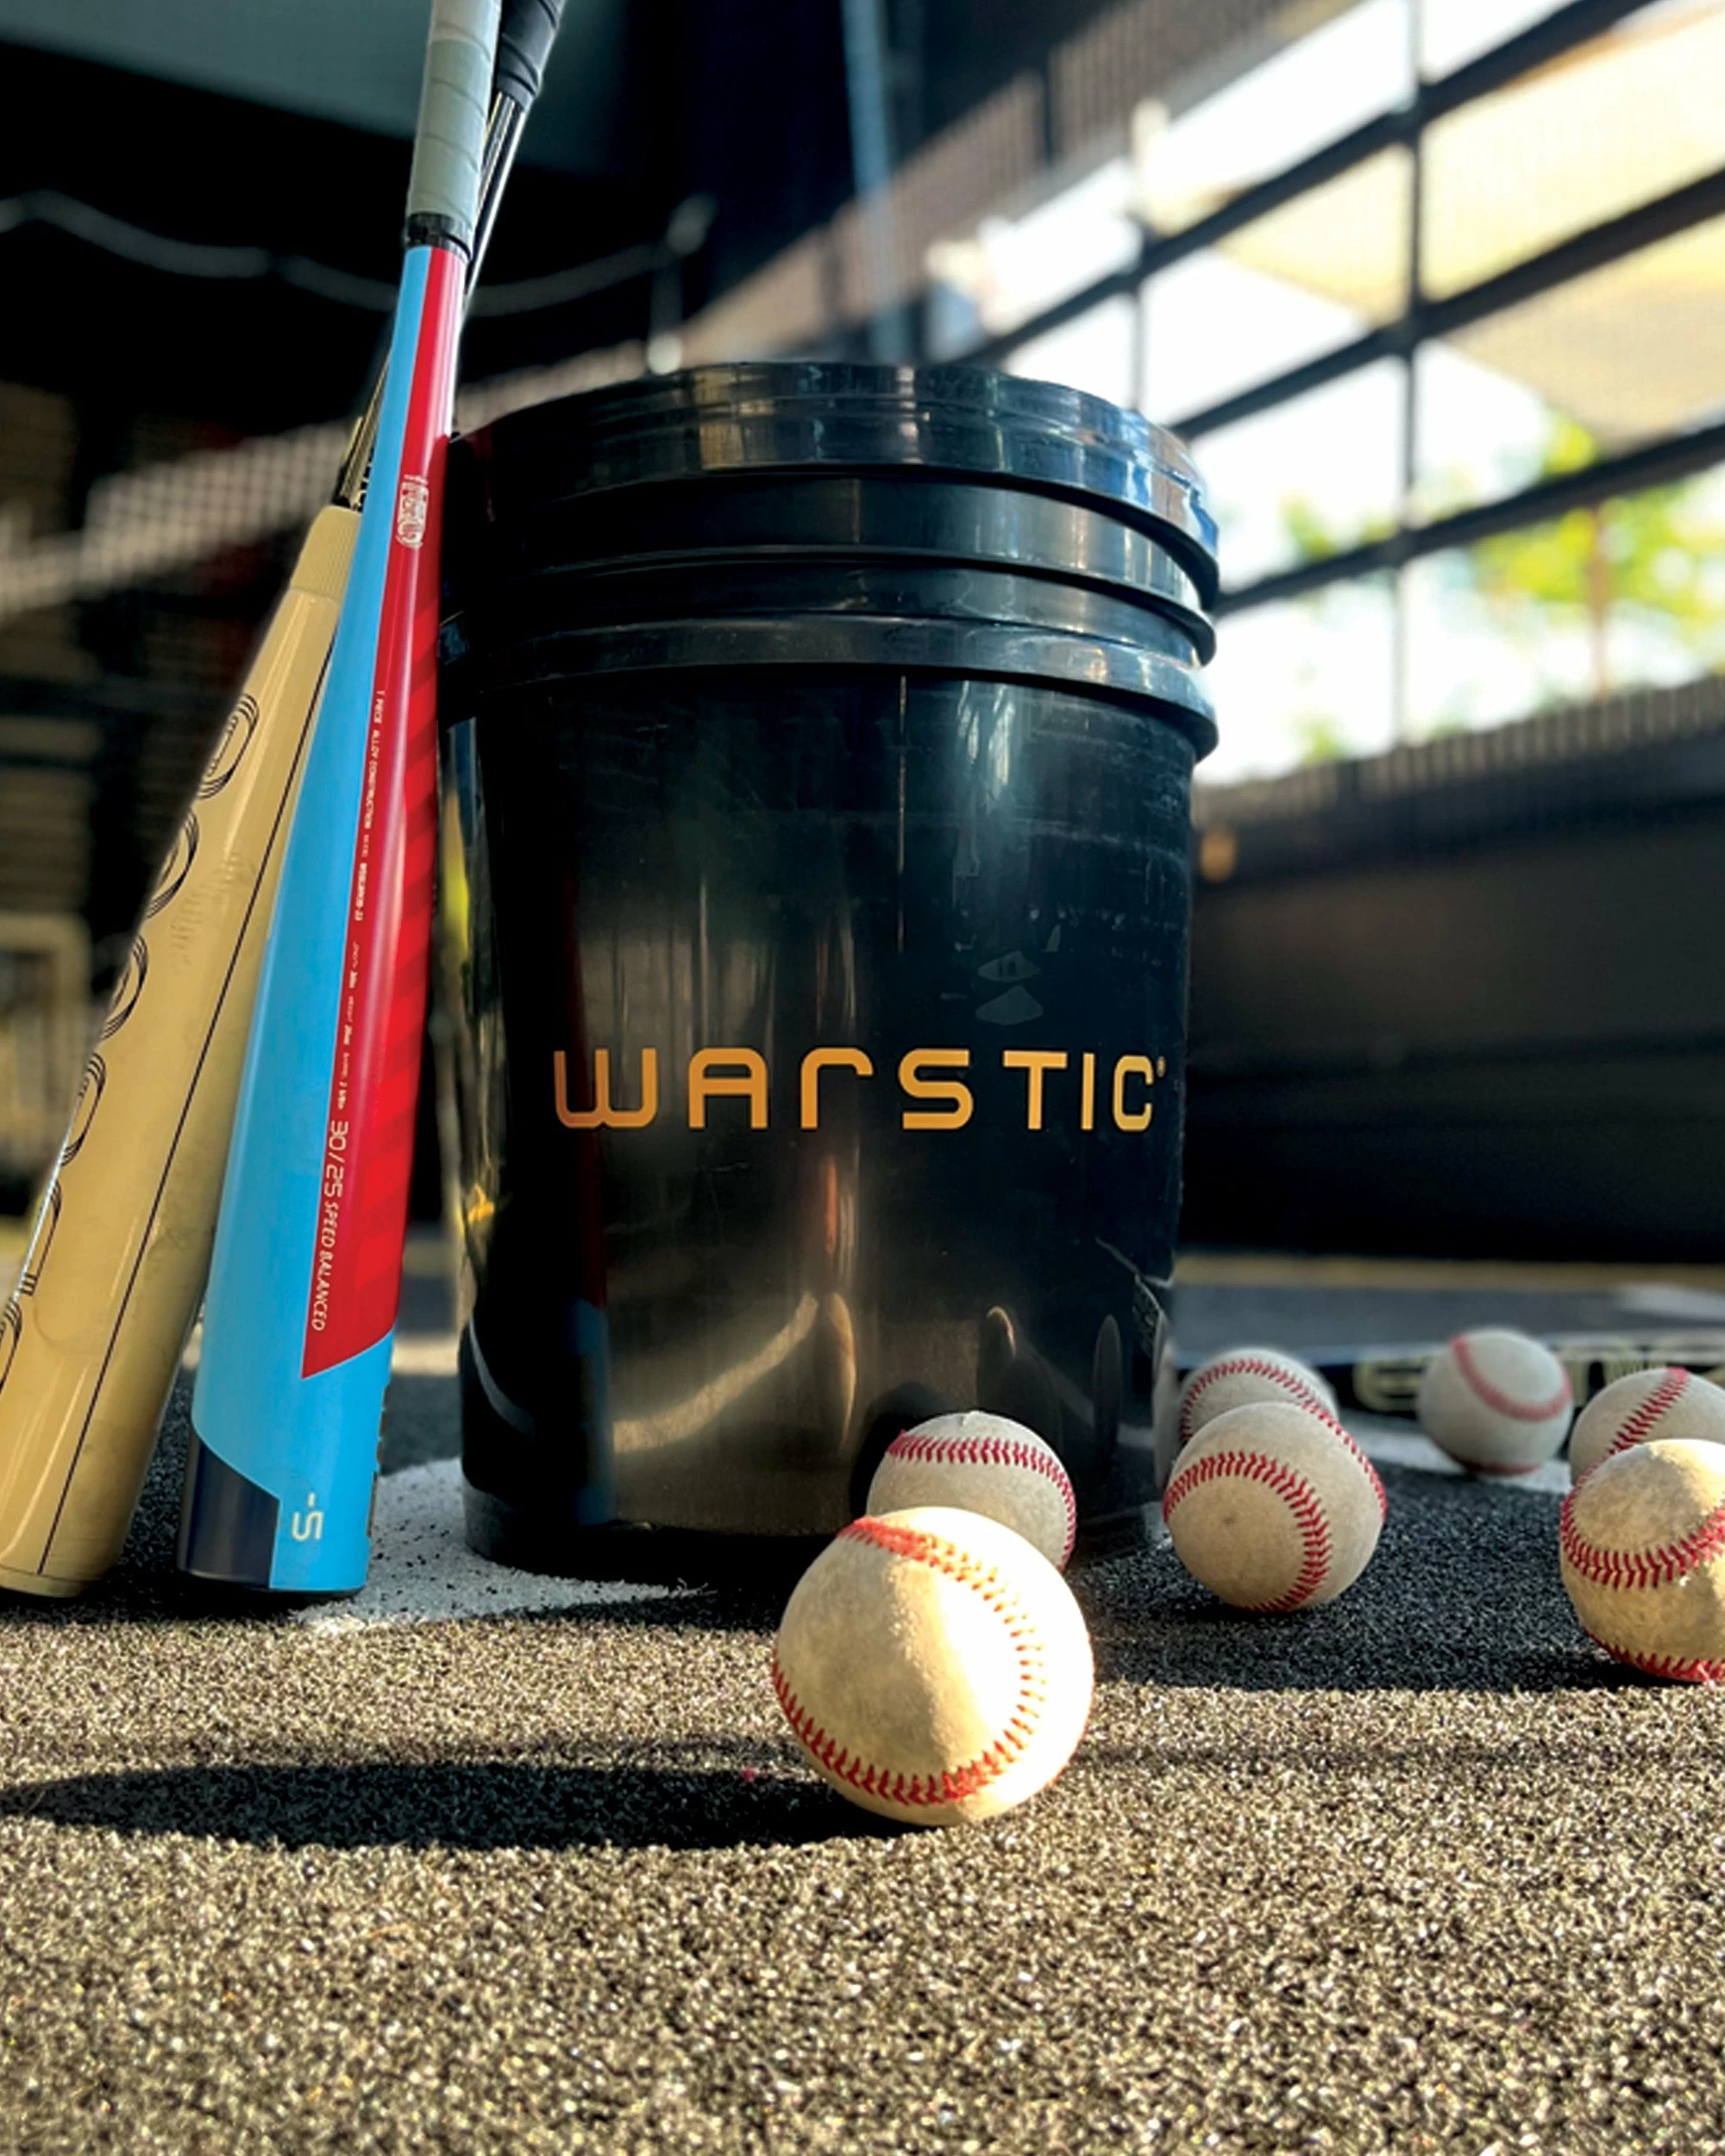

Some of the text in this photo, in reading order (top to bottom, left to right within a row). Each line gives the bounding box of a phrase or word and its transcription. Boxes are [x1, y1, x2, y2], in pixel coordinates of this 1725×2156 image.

[371, 730, 380, 757] ALLOY
[324, 1120, 348, 1198] 30/25
[321, 1201, 338, 1248] SPEED
[312, 1250, 333, 1331] BALANCED
